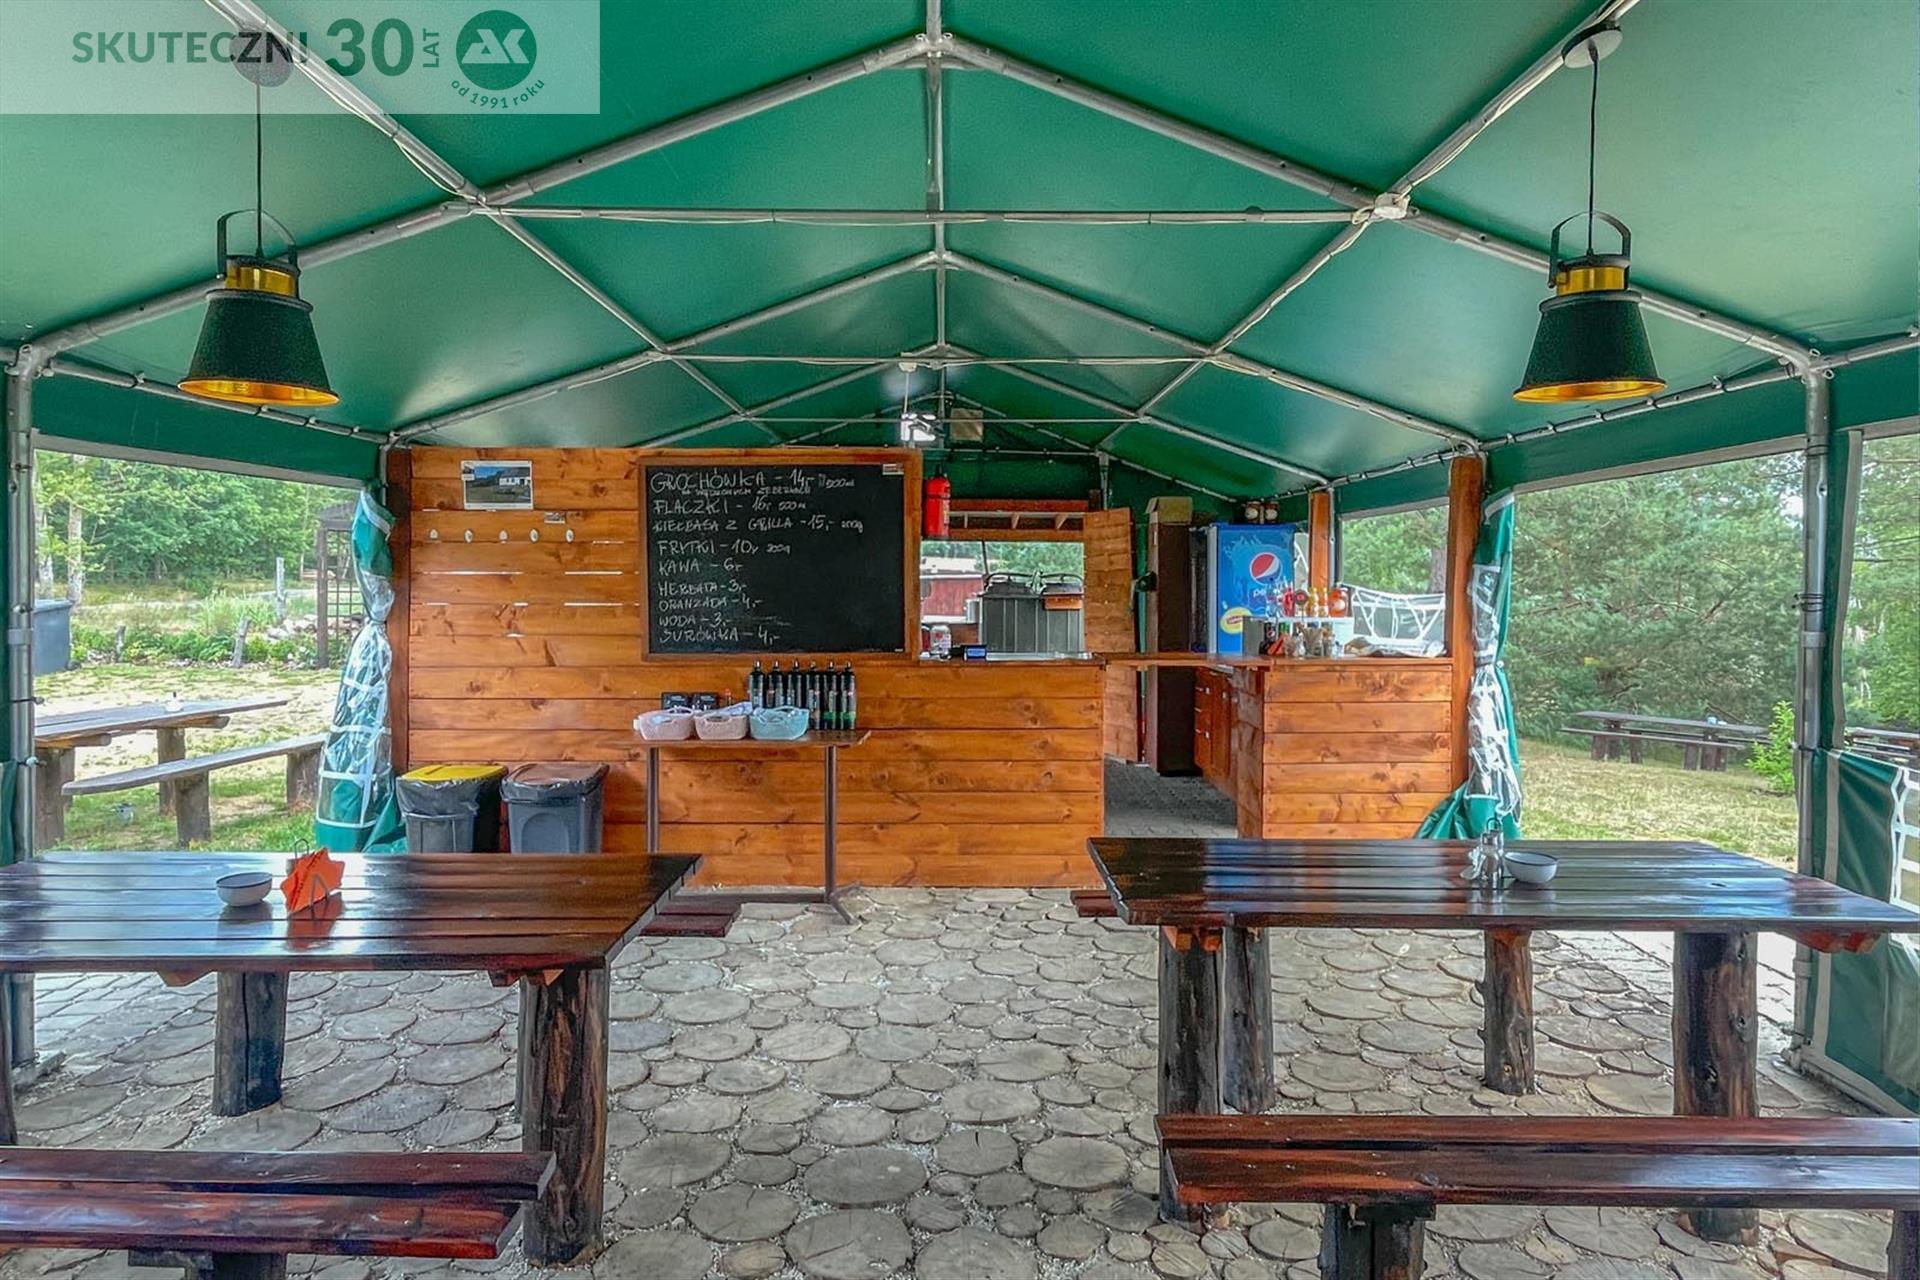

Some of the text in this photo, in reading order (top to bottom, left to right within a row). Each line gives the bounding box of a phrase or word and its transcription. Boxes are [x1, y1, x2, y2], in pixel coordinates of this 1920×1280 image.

[650, 467, 765, 494] GROCHÓWKA
[747, 517, 793, 531] GRILLA
[657, 539, 715, 556] FRYTKI
[659, 558, 700, 576] KAWA
[658, 580, 718, 596] HERBATA
[659, 615, 696, 627] WODA
